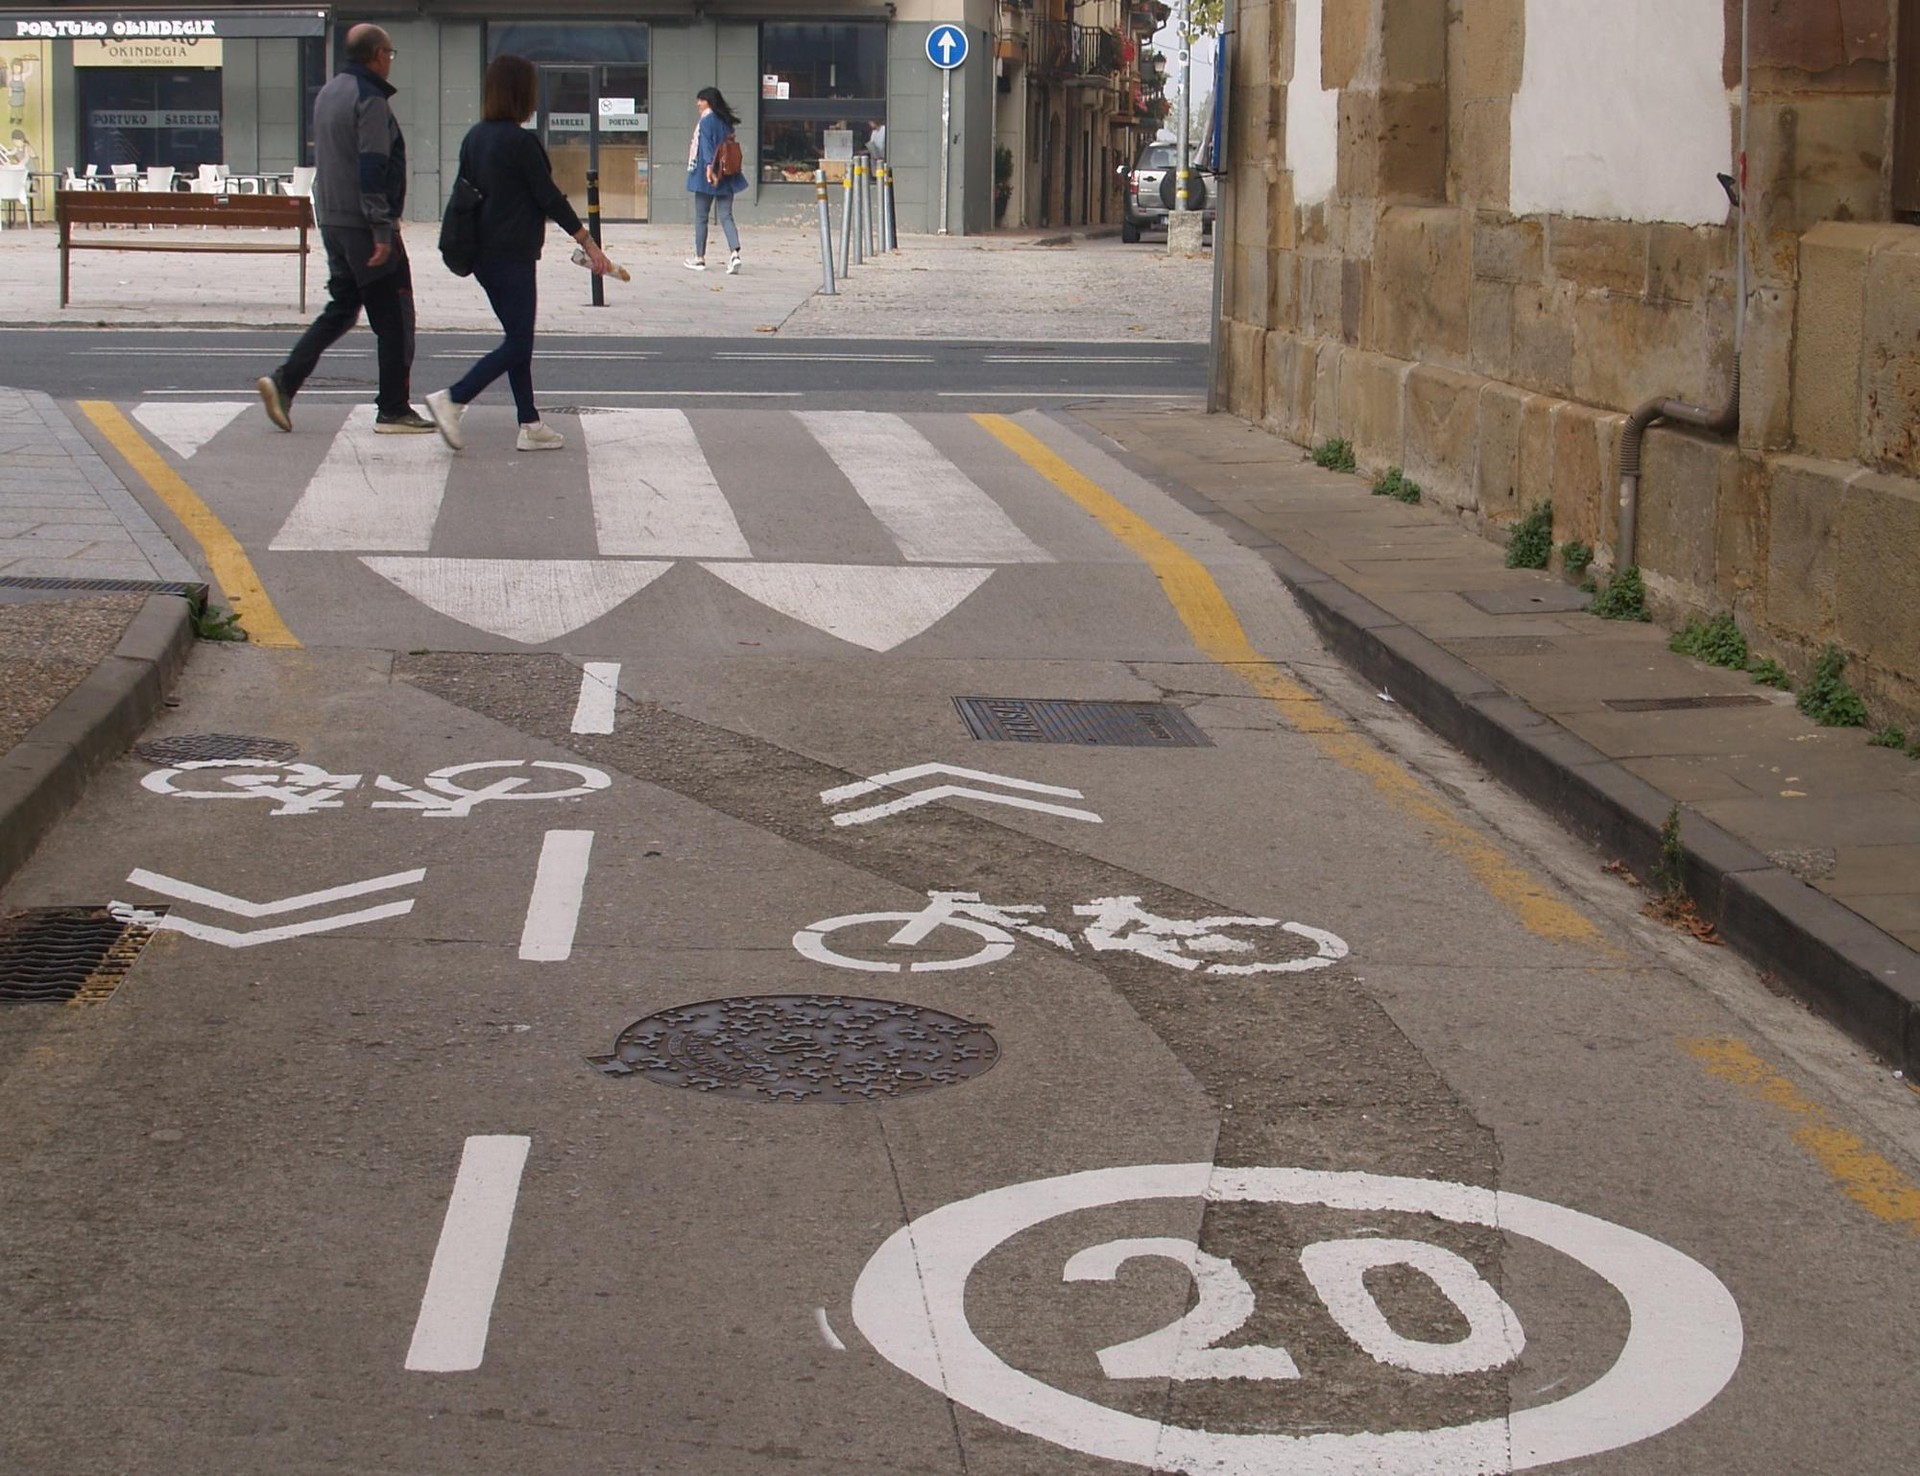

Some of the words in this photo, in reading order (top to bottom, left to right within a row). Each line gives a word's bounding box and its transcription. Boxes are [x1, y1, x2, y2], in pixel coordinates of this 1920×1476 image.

[16, 21, 107, 37] PORTUKO
[113, 20, 216, 36] OKINDEGIA
[109, 46, 188, 57] OKINDEGIA
[94, 114, 148, 125] PORTUKO
[164, 114, 219, 125] SARRERA
[1062, 1237, 1527, 1380] 20
